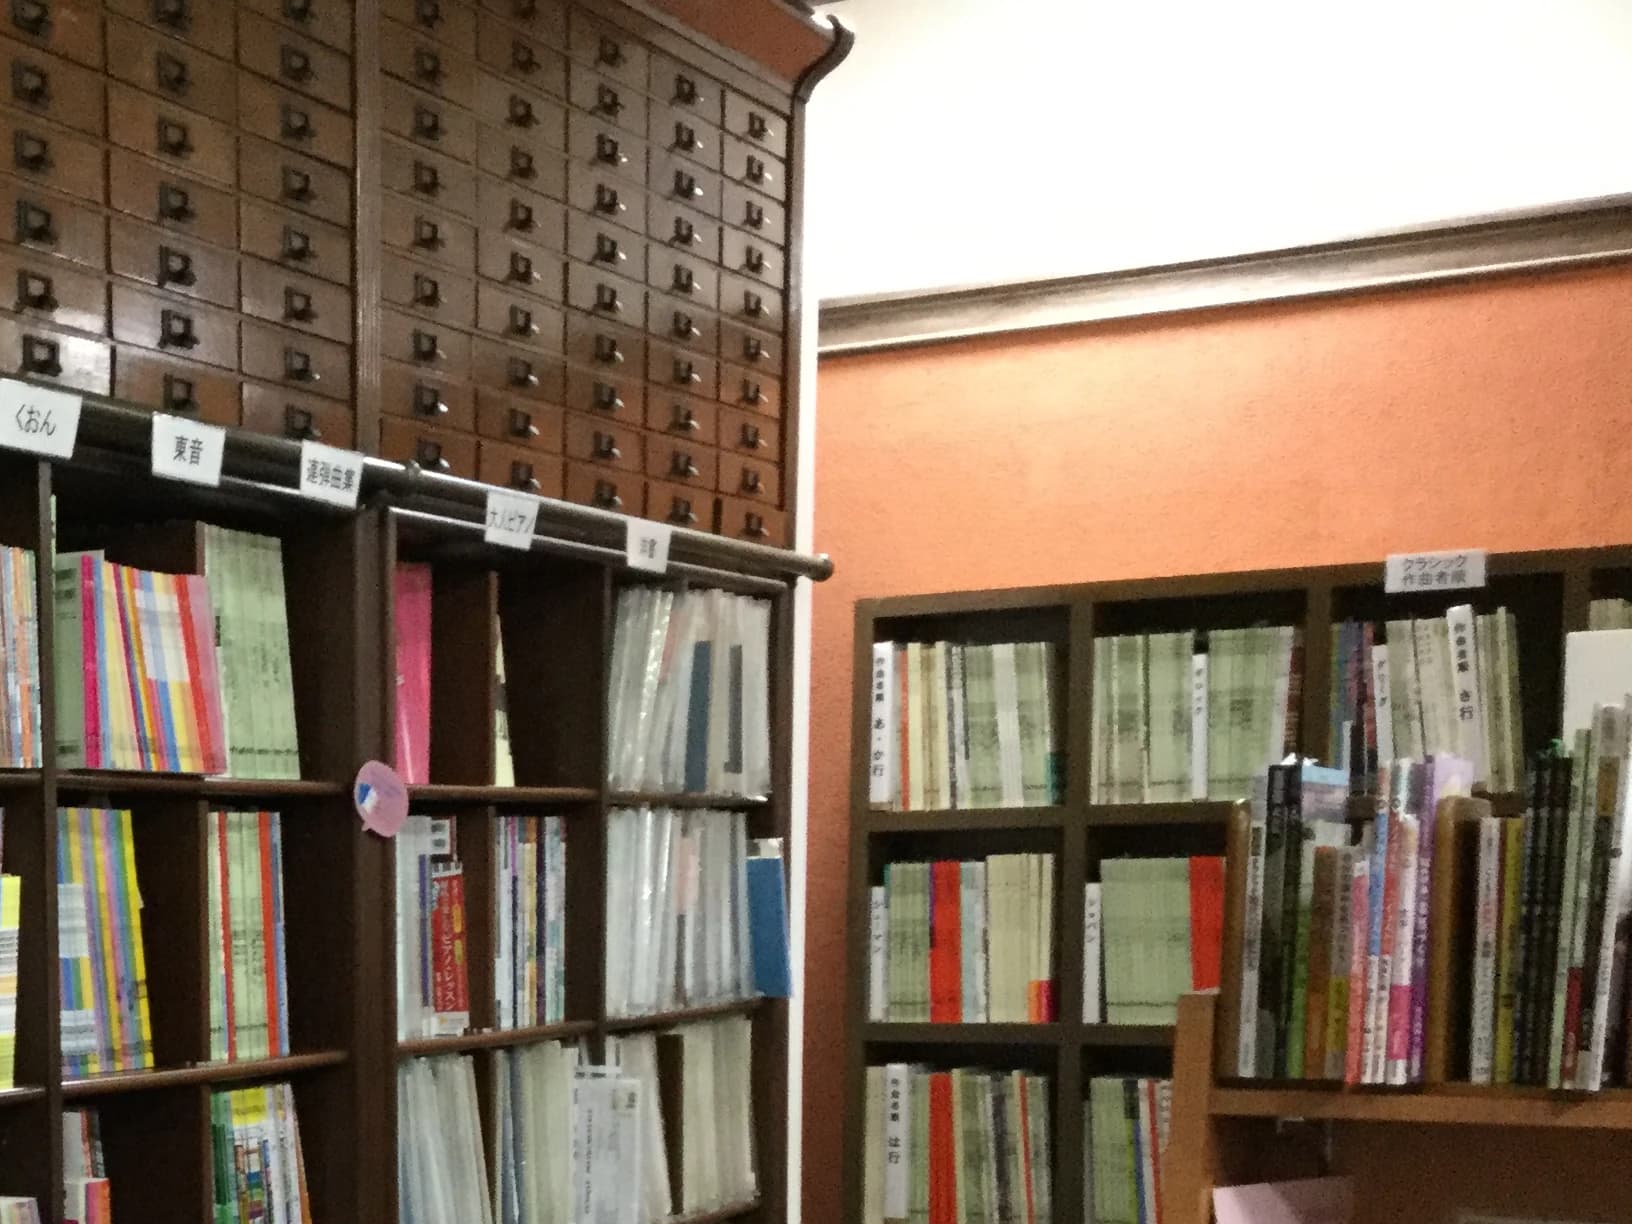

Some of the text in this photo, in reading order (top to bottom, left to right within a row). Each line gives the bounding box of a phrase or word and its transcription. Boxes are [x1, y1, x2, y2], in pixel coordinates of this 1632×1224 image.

[15, 404, 56, 436] くおん
[173, 434, 204, 466] 東音
[1402, 554, 1467, 572] クラシック
[1400, 569, 1467, 587] 作曲者順
